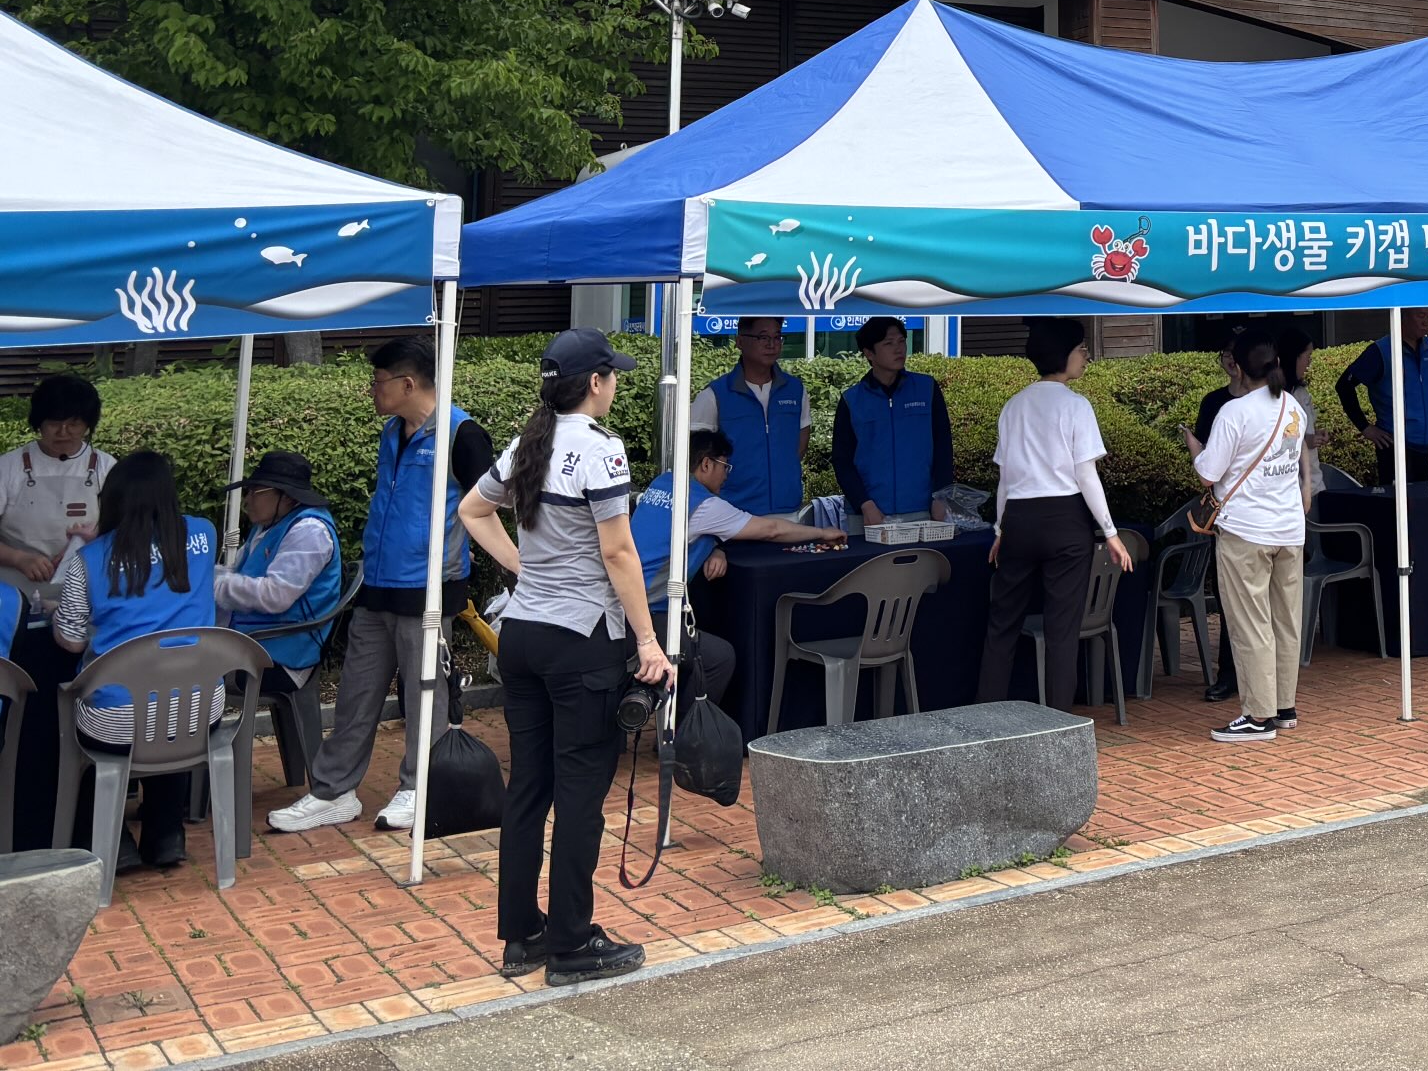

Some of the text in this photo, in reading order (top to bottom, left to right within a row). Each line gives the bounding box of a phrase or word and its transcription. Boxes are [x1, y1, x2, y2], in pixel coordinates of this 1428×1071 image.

[1186, 218, 1333, 272] 바다생물
[1345, 218, 1410, 270] 키캡
[561, 451, 580, 476] 찰
